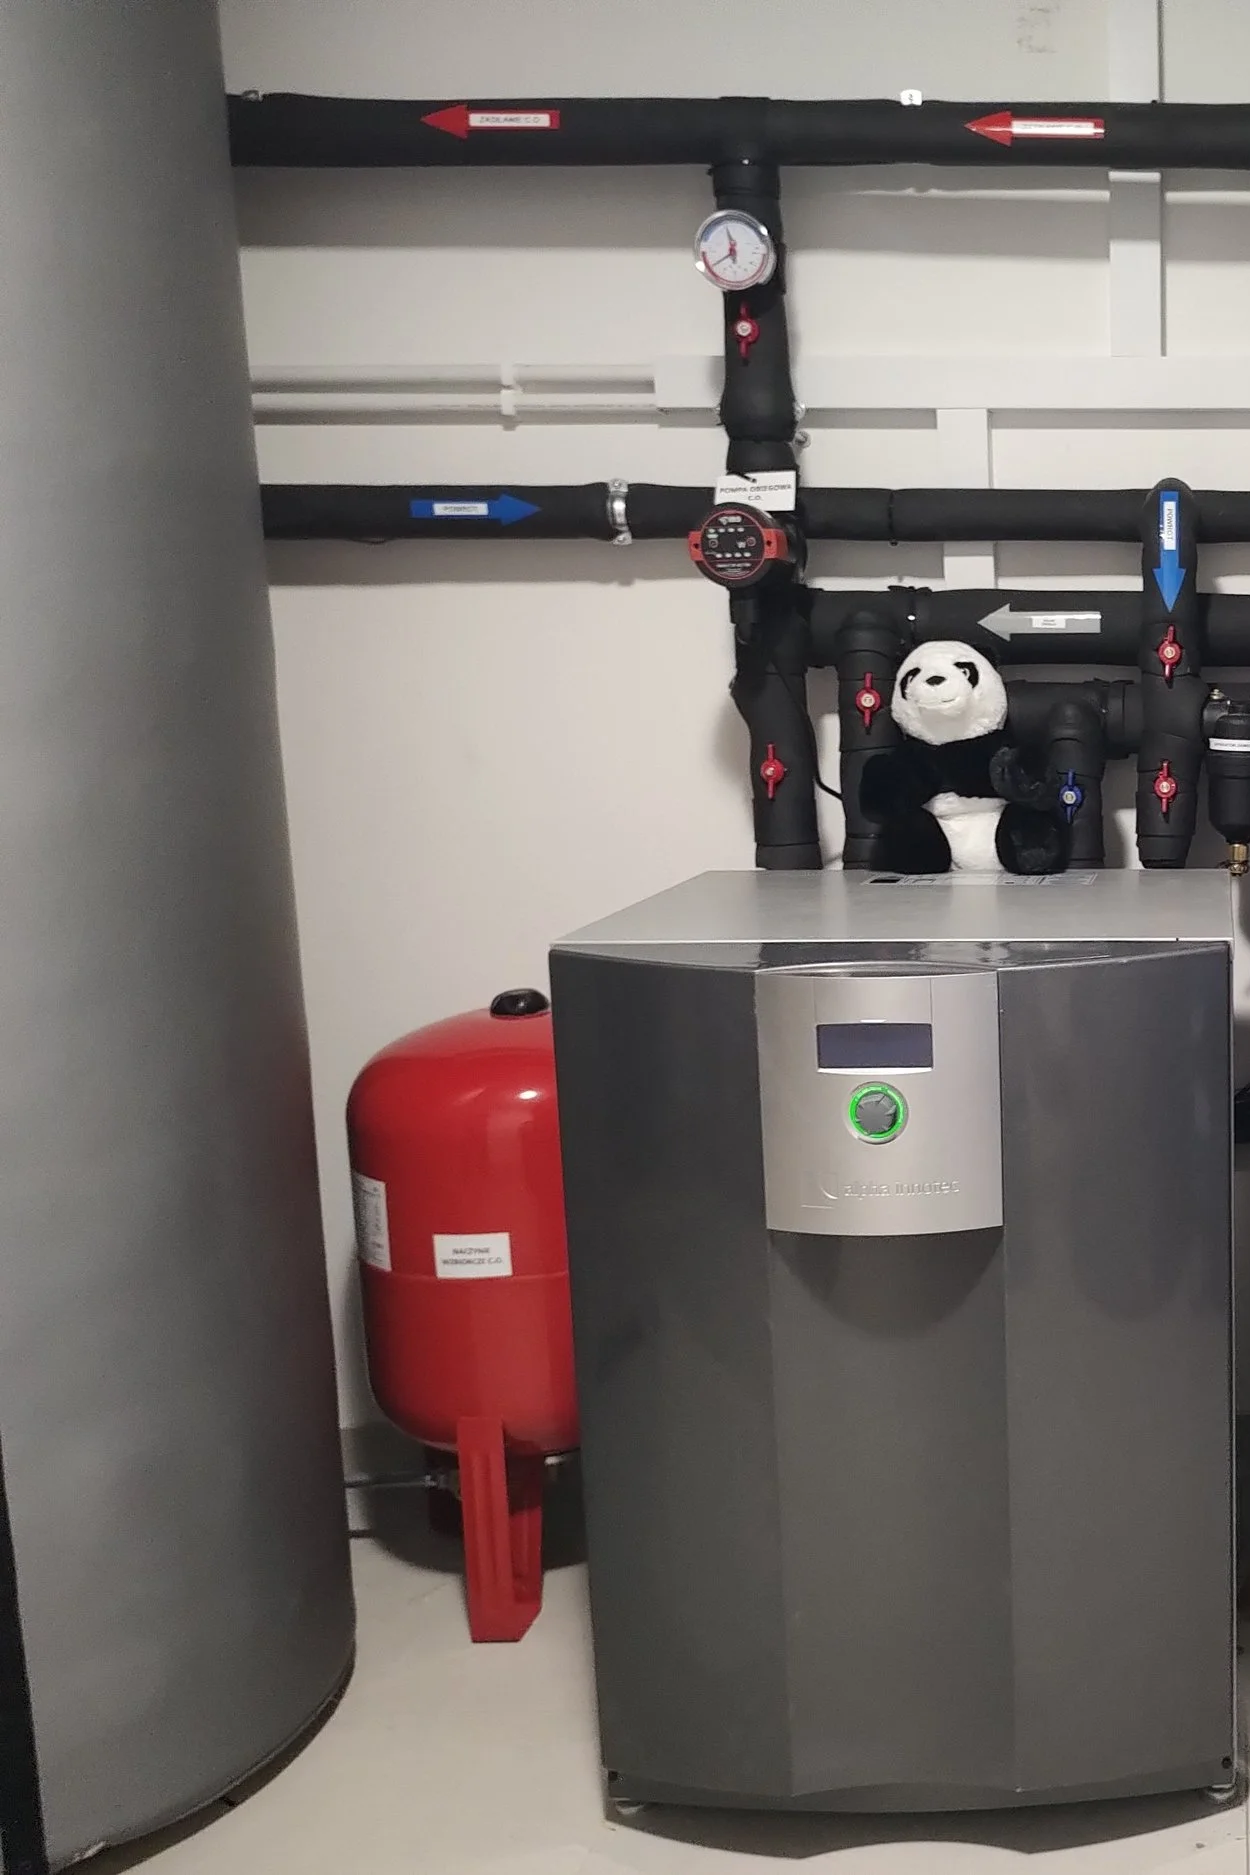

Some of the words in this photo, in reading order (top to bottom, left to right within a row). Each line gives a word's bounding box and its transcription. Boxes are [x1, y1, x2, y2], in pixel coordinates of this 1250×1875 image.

[719, 486, 748, 494] POMPA
[749, 484, 792, 493] OBIEGOWA
[843, 1180, 891, 1200] alpha
